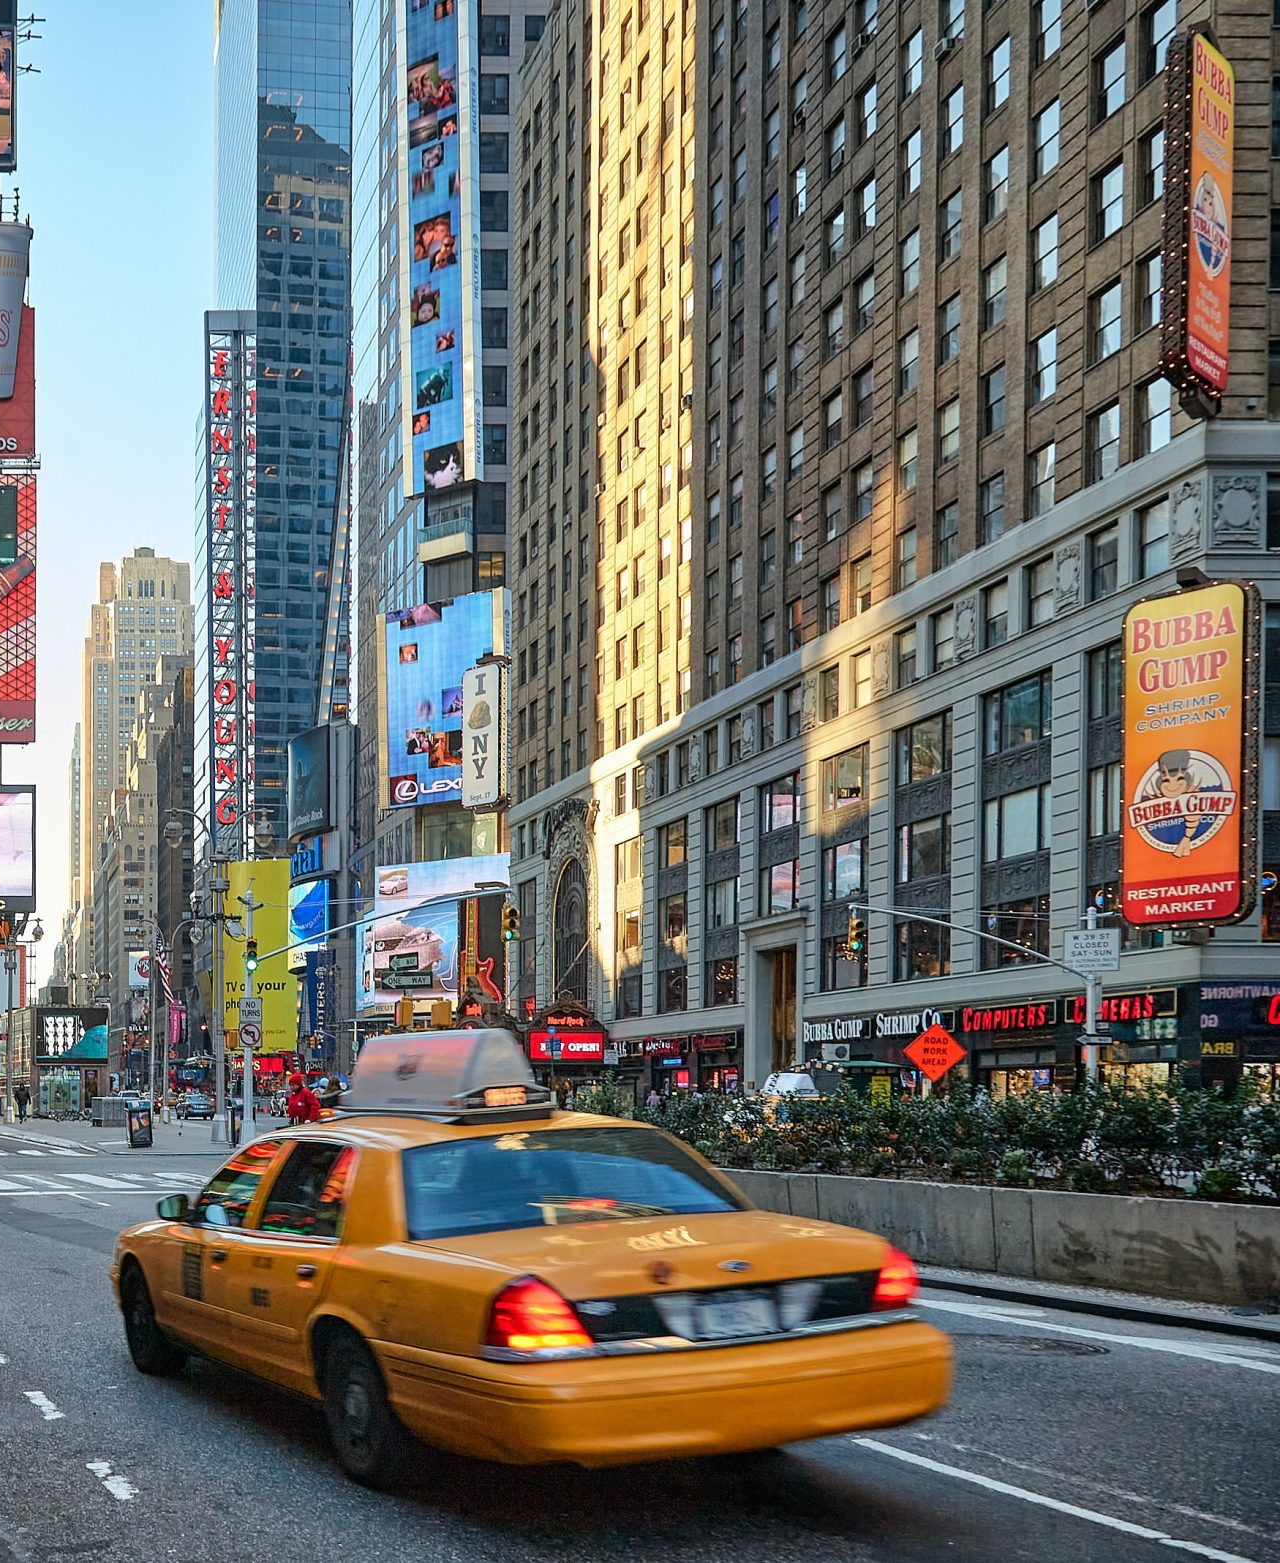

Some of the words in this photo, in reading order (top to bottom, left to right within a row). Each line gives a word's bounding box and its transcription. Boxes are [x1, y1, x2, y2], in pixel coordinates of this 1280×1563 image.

[1196, 40, 1232, 106] BUBBA
[1197, 86, 1229, 140] GUMP
[213, 352, 232, 530] ERNST
[1131, 606, 1238, 654] BUBBA
[1138, 650, 1229, 694] GUMP
[1145, 693, 1220, 717] SHRIMP
[1136, 705, 1231, 732] COMPANY
[215, 638, 237, 825] YOUNG
[420, 779, 463, 795] LEX
[1132, 799, 1182, 824] BUBBA
[1186, 795, 1233, 813] GUMP
[1147, 817, 1185, 831] SHRIMP
[1200, 815, 1215, 823] CO
[1127, 880, 1236, 901] RESTAURANT
[1145, 899, 1216, 916] MARKET
[1074, 941, 1109, 949] CLOSED
[1099, 932, 1111, 940] ST
[226, 982, 237, 992] TV
[257, 982, 286, 994] your
[389, 977, 403, 985] ONE
[412, 976, 427, 984] WAY
[242, 1009, 261, 1017] TURNS
[245, 1001, 256, 1009] NO
[1073, 994, 1154, 1024] CERAS
[548, 1016, 567, 1026] Hard
[569, 1016, 585, 1026] Rock
[803, 1019, 833, 1042] BUBBA
[835, 1016, 863, 1038] GUMP
[876, 1013, 920, 1037] SHRIMP
[962, 1005, 1046, 1033] COMPUTERS
[568, 1043, 600, 1052] OPEN!
[924, 1037, 948, 1045] ROAD
[922, 1058, 946, 1066] AHEAD
